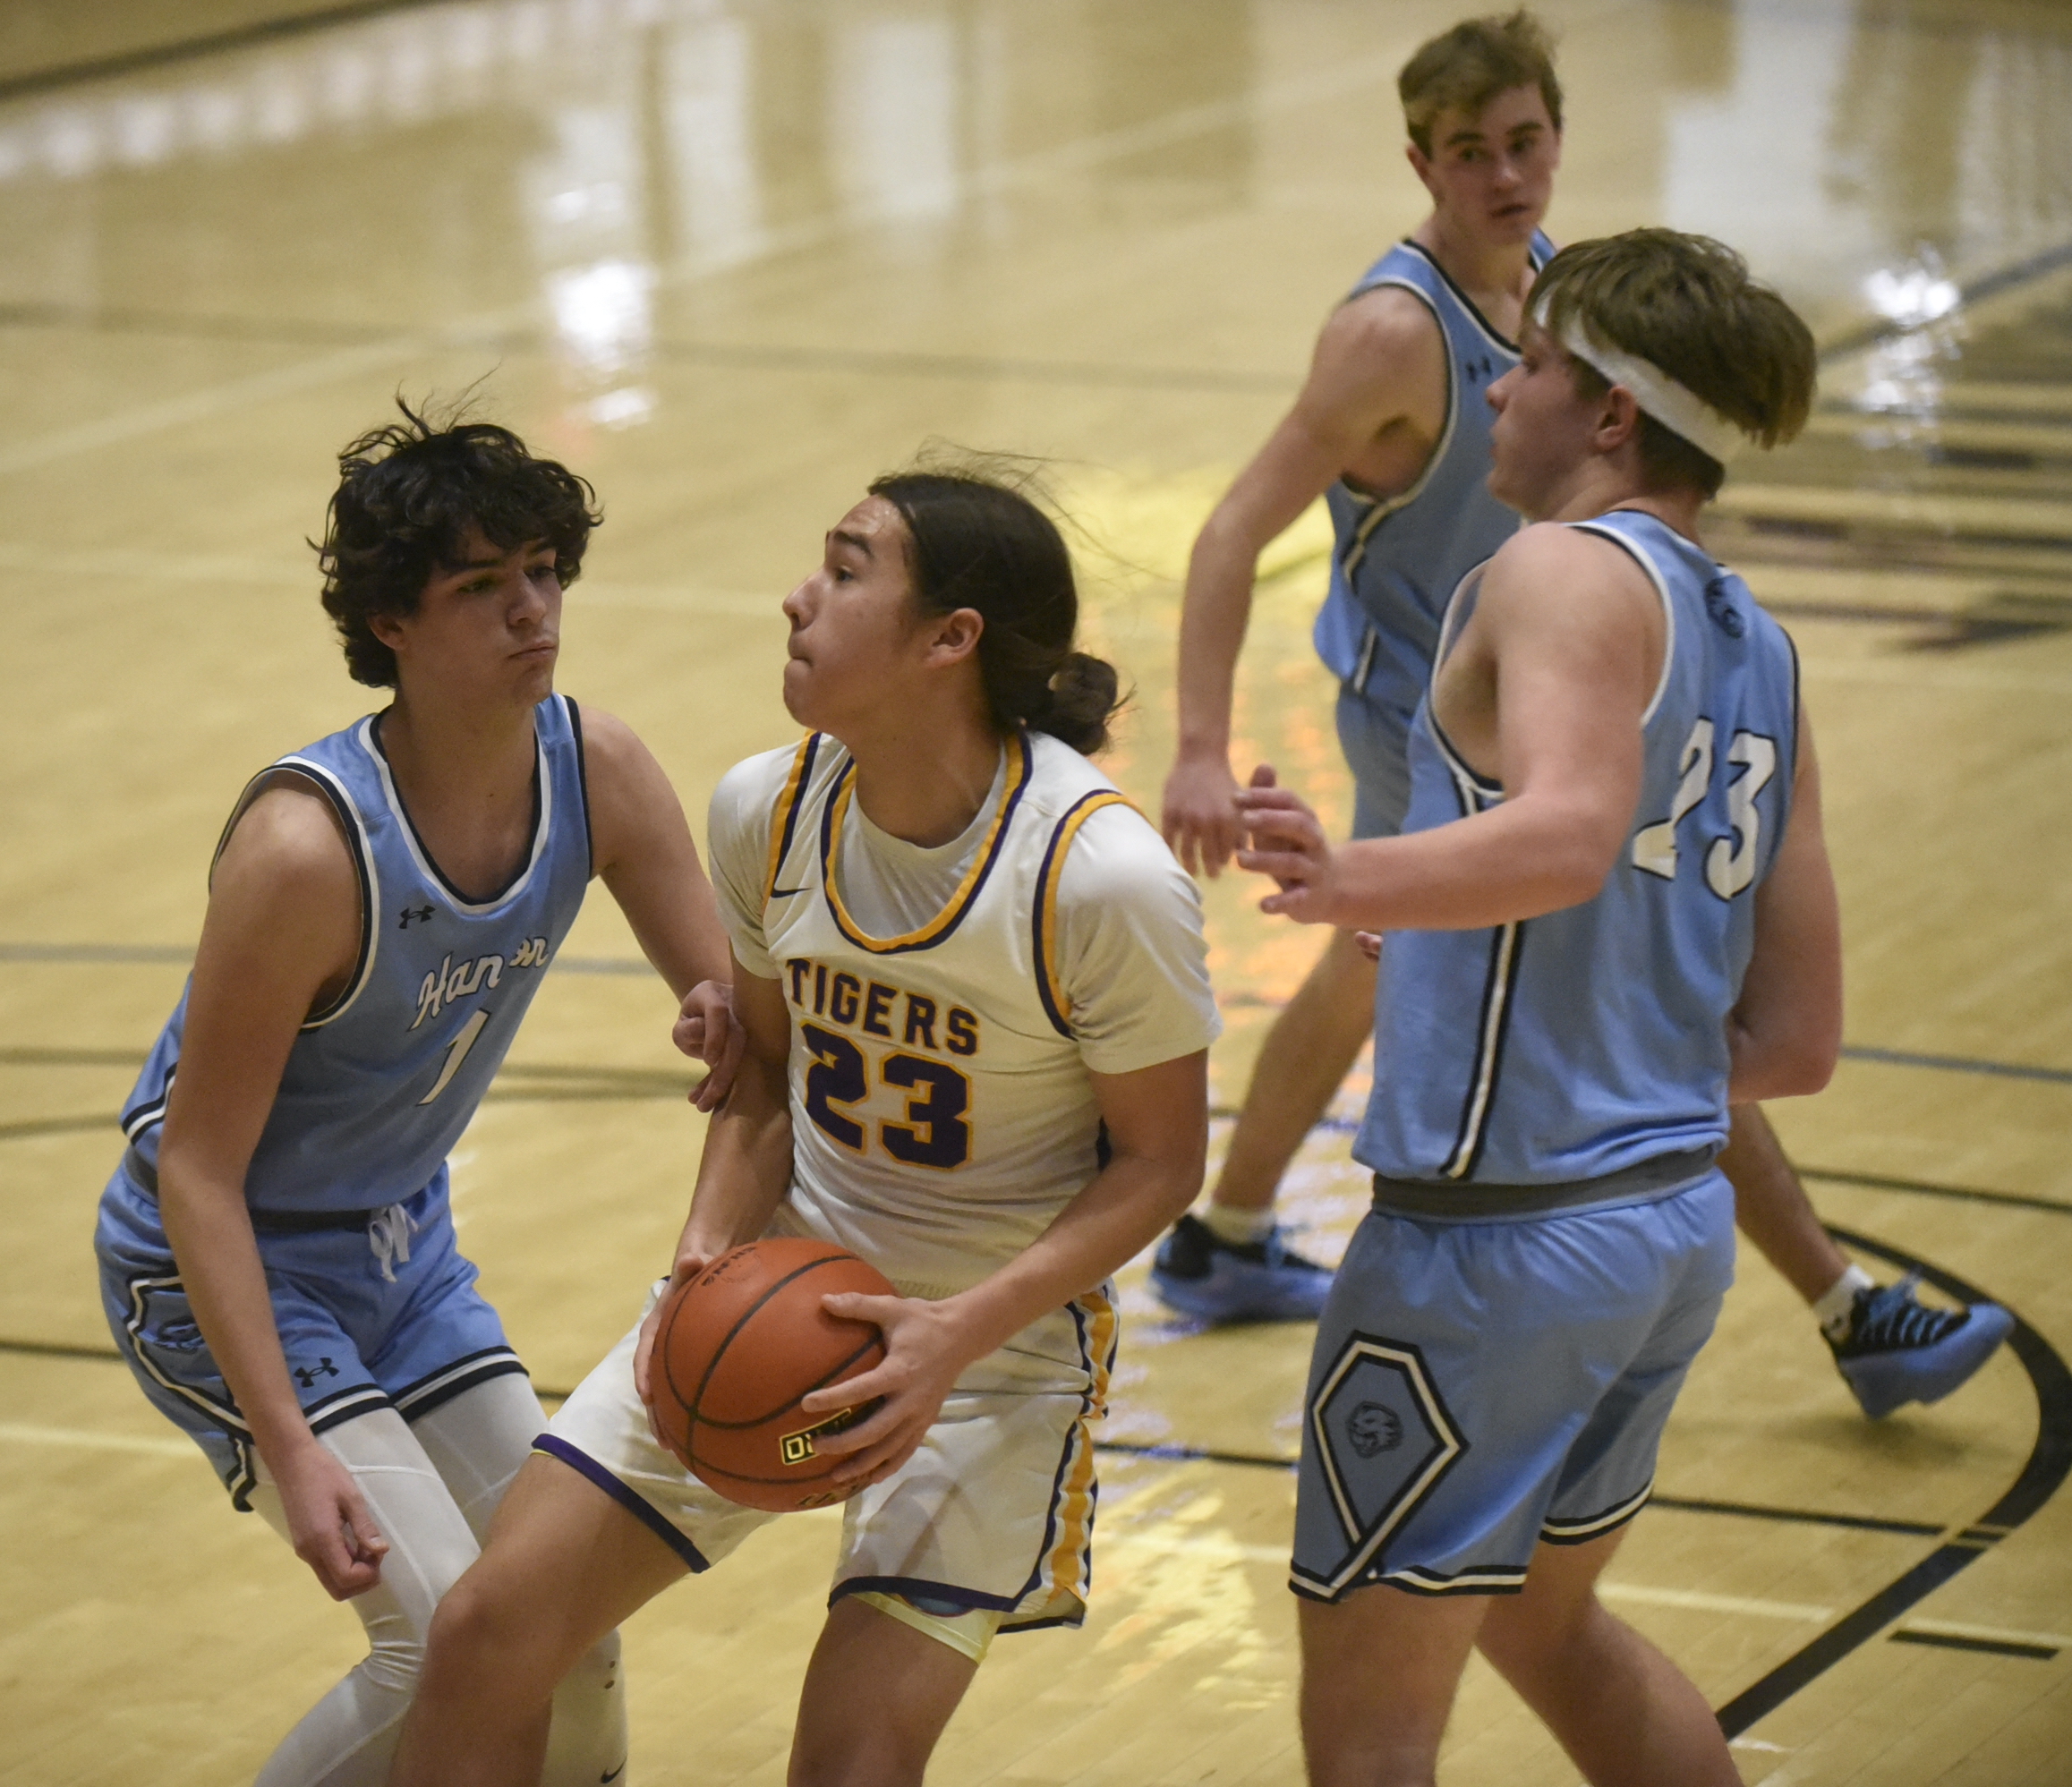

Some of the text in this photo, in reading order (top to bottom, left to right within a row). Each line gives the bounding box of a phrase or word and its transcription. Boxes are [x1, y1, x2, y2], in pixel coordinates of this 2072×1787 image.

[1632, 715, 1777, 903] 23
[415, 1007, 491, 1106] 1
[785, 957, 981, 1057] TIGERS
[799, 1017, 974, 1172] 23
